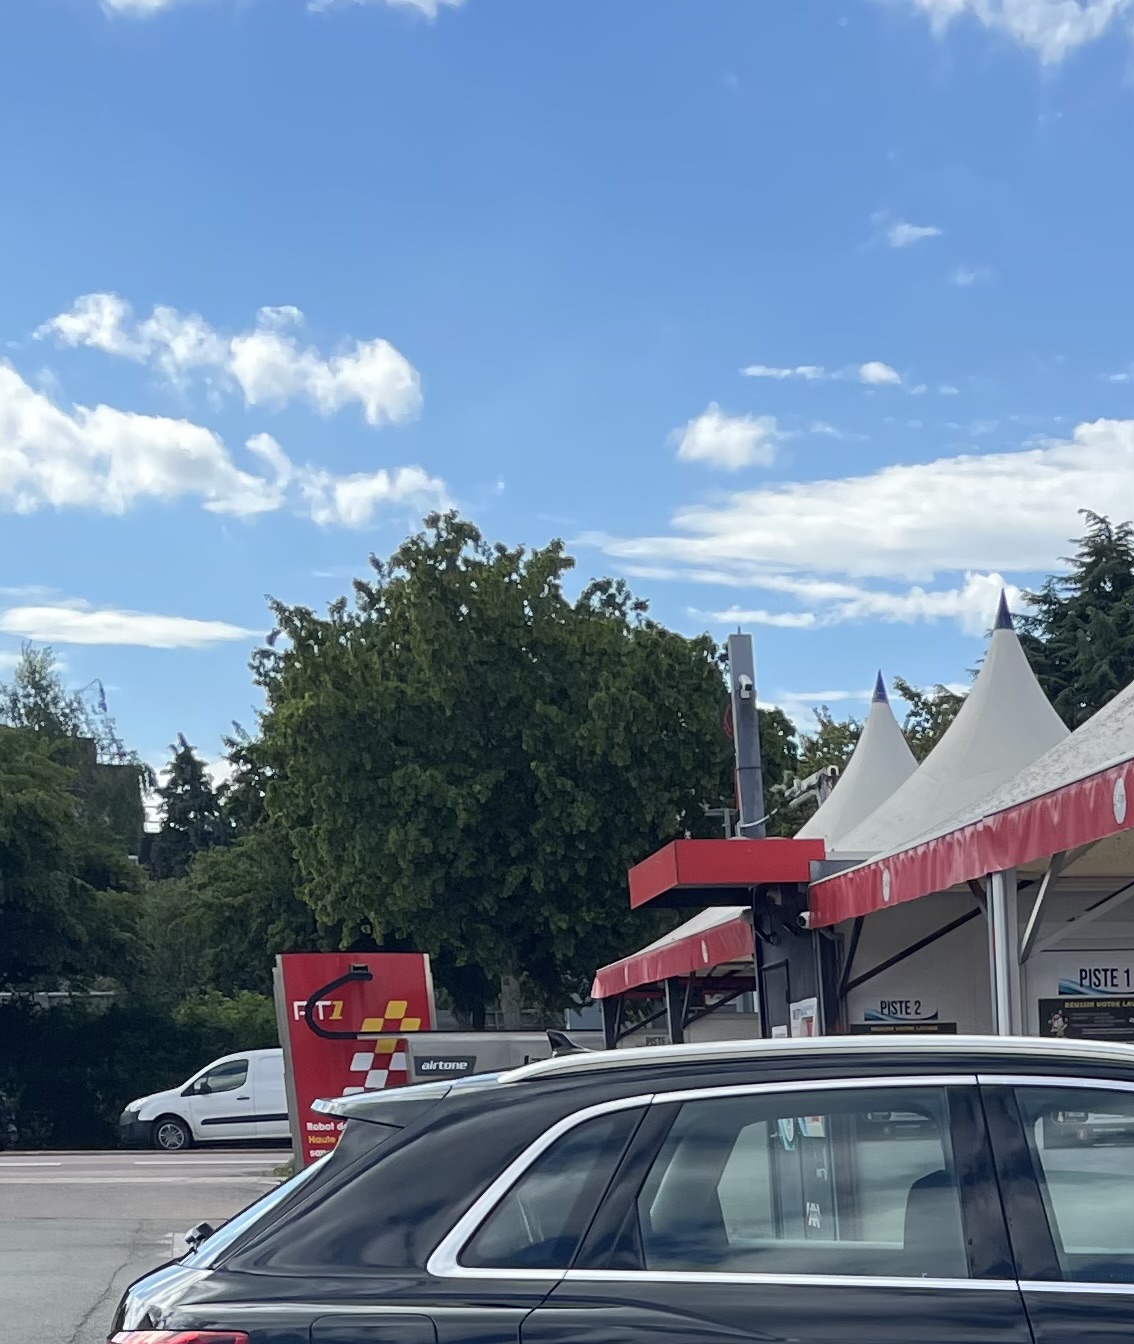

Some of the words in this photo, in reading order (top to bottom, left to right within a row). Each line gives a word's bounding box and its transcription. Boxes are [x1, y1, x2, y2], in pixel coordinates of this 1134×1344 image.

[1079, 967, 1119, 988] PISTE
[1123, 967, 1131, 988] 1
[880, 1000, 911, 1015] PISTE
[914, 1000, 921, 1015] 2
[421, 1060, 468, 1071] airtone
[306, 1121, 335, 1131] Robot
[308, 1135, 336, 1144] Haute
